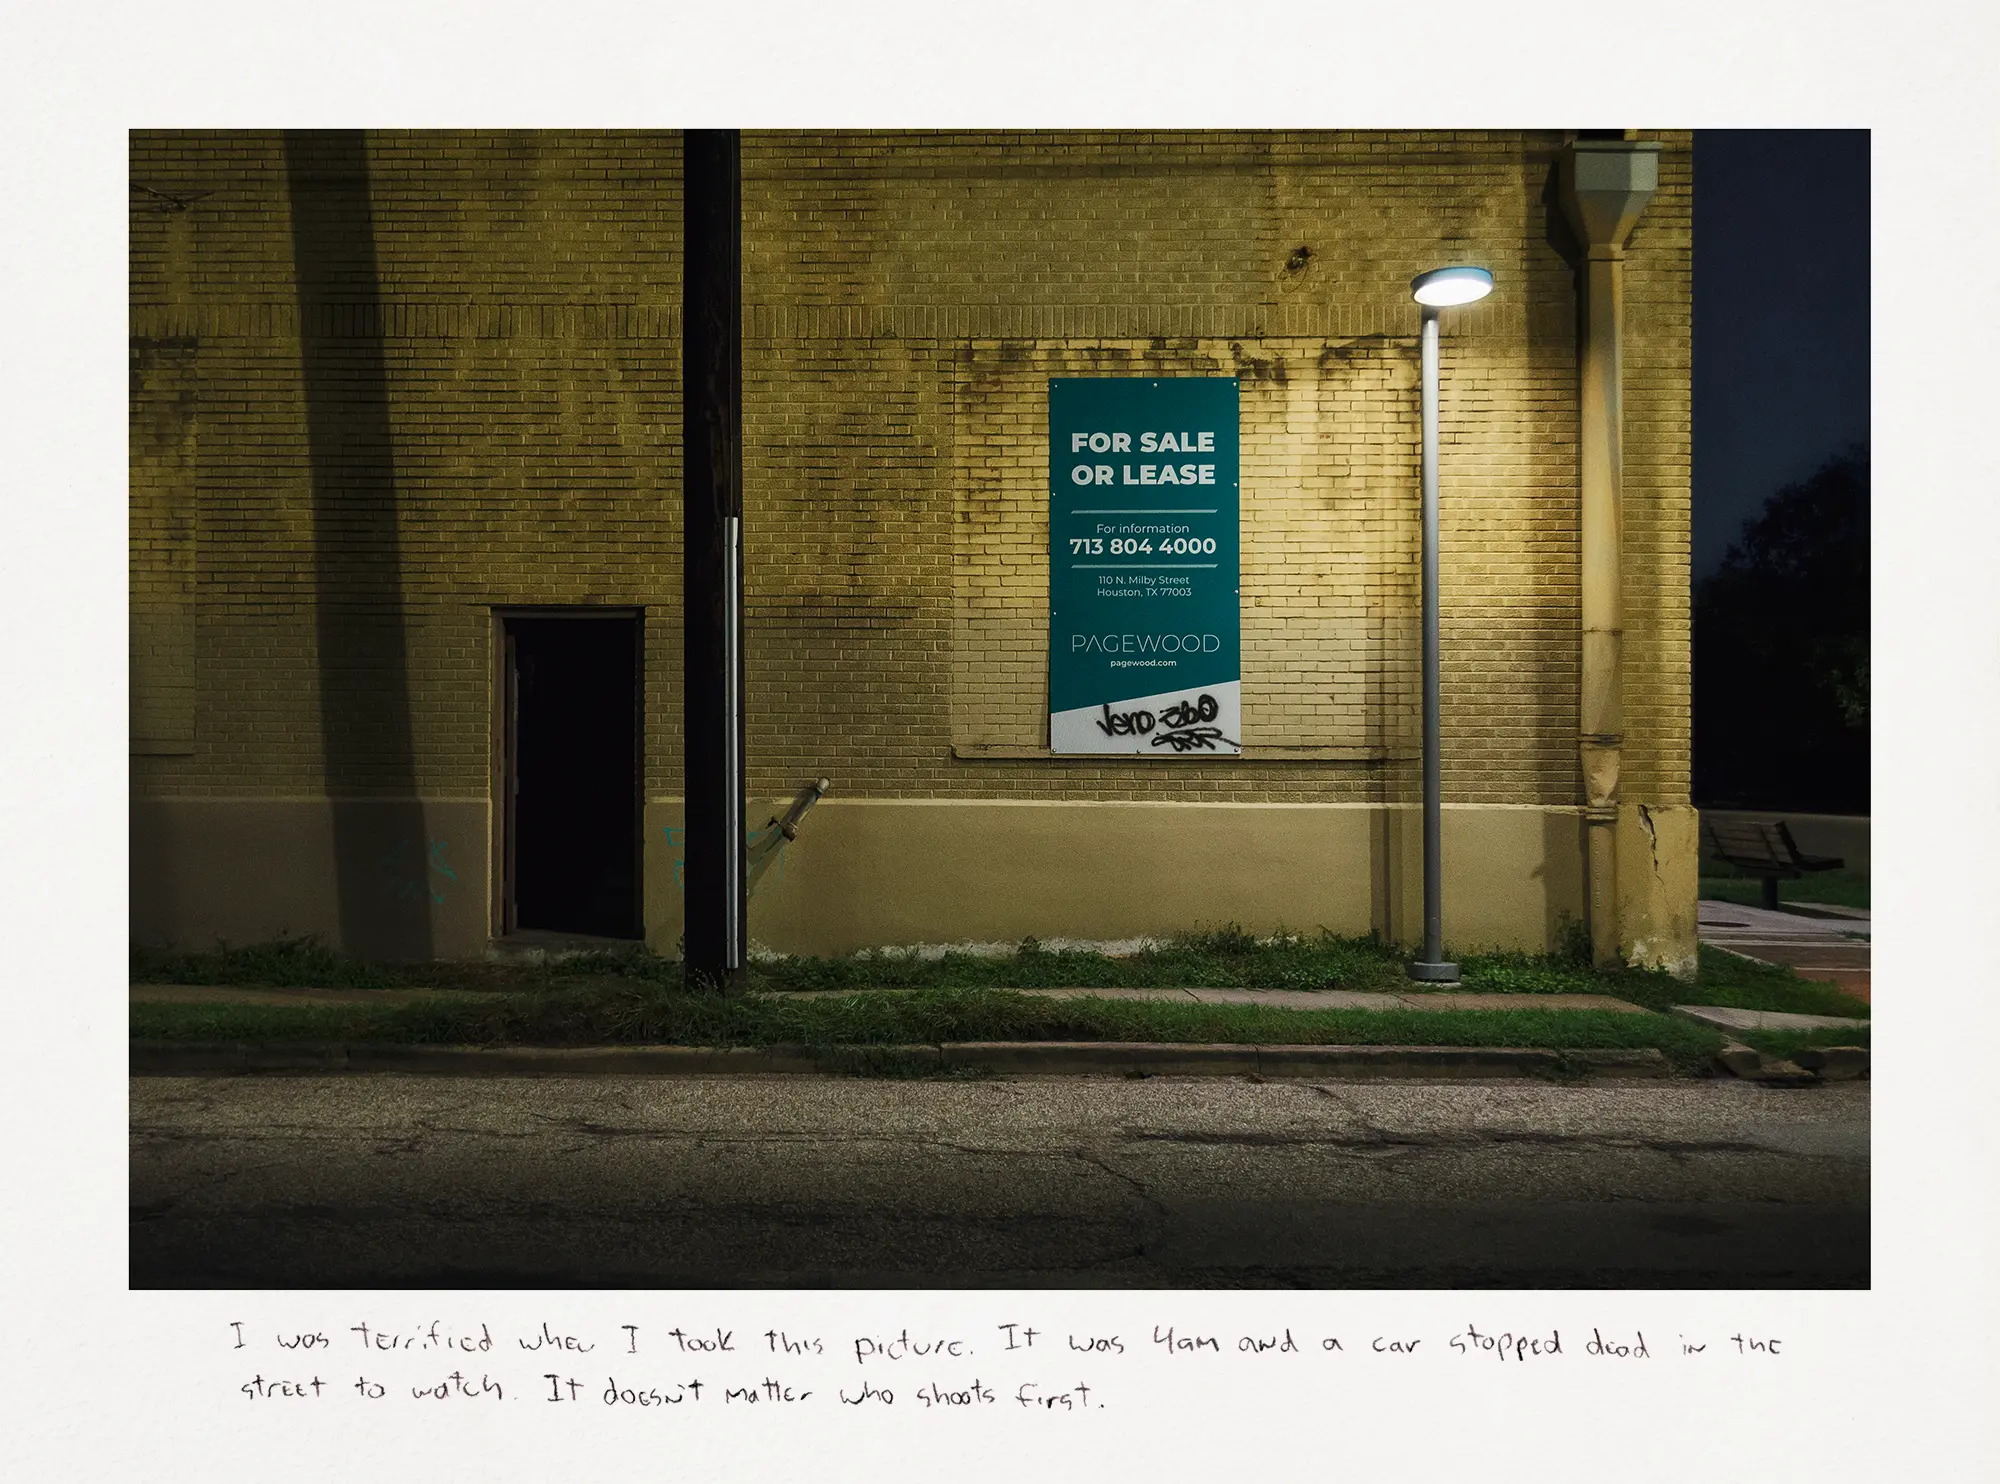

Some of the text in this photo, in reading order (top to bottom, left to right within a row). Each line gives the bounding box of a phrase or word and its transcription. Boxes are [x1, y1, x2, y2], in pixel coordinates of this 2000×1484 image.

[1072, 431, 1215, 453] FOR SALE
[1071, 464, 1216, 486] OR LEASE
[1096, 523, 1190, 534] For information
[1069, 537, 1217, 555] 713 804 4000
[1098, 575, 1190, 587] 110 N. Milby Street
[1097, 588, 1192, 598] Houston, TX 77003
[1072, 634, 1221, 653] PAGEWOOD
[1110, 659, 1177, 669] pagewood.com
